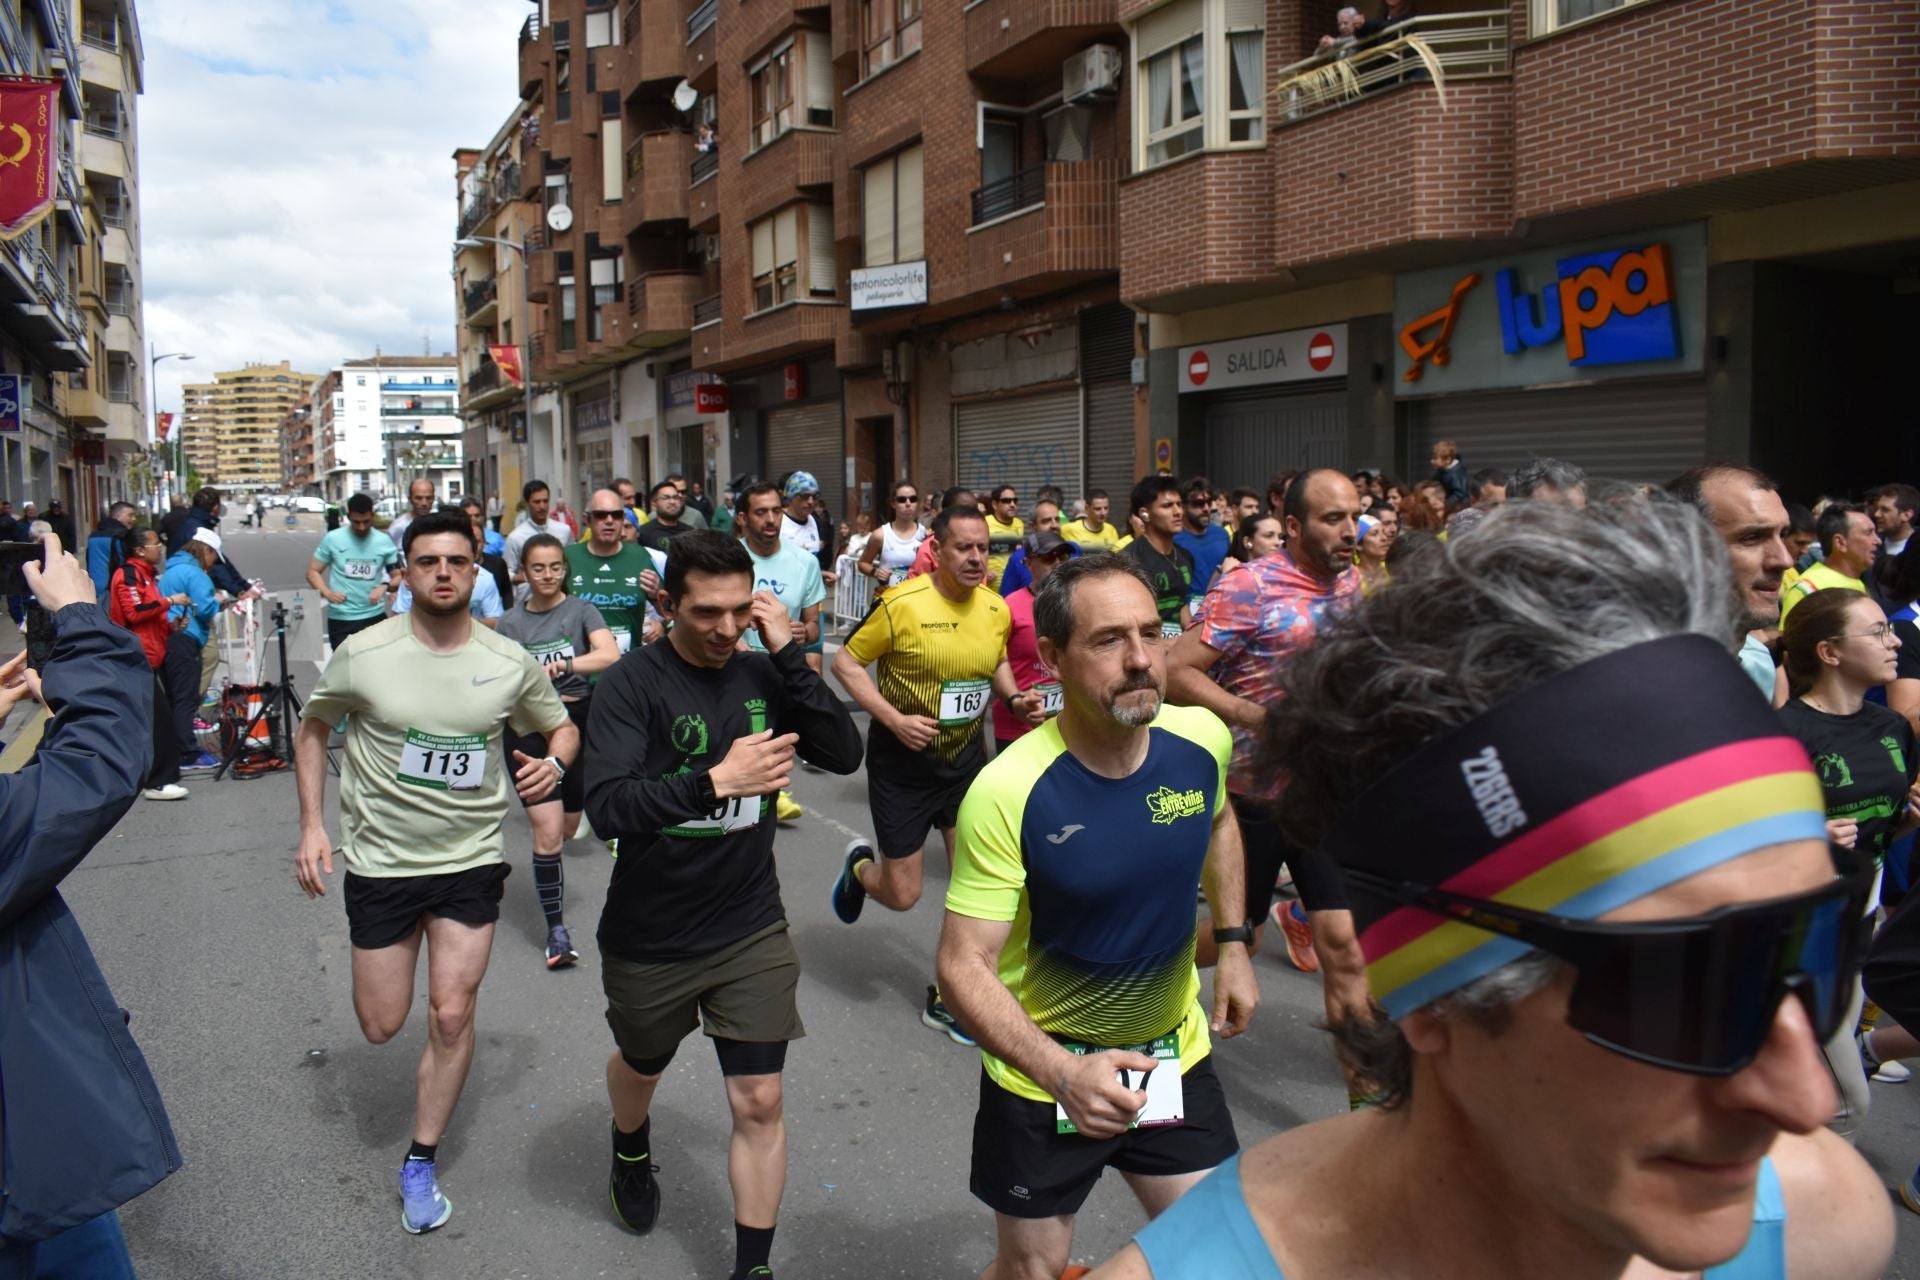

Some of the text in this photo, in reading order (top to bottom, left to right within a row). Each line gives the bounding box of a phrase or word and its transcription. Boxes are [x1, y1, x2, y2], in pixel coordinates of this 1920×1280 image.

[36, 95, 48, 198] PASO VIVIENTE
[1495, 243, 1670, 361] lupa
[1226, 347, 1288, 374] SALIDA
[352, 564, 371, 575] 240
[954, 692, 982, 713] 163
[426, 735, 454, 744] CARRERA
[455, 736, 479, 744] POPULAR
[421, 751, 470, 776] 113
[1460, 744, 1527, 837] 226ERS
[1074, 1048, 1086, 1056] XV
